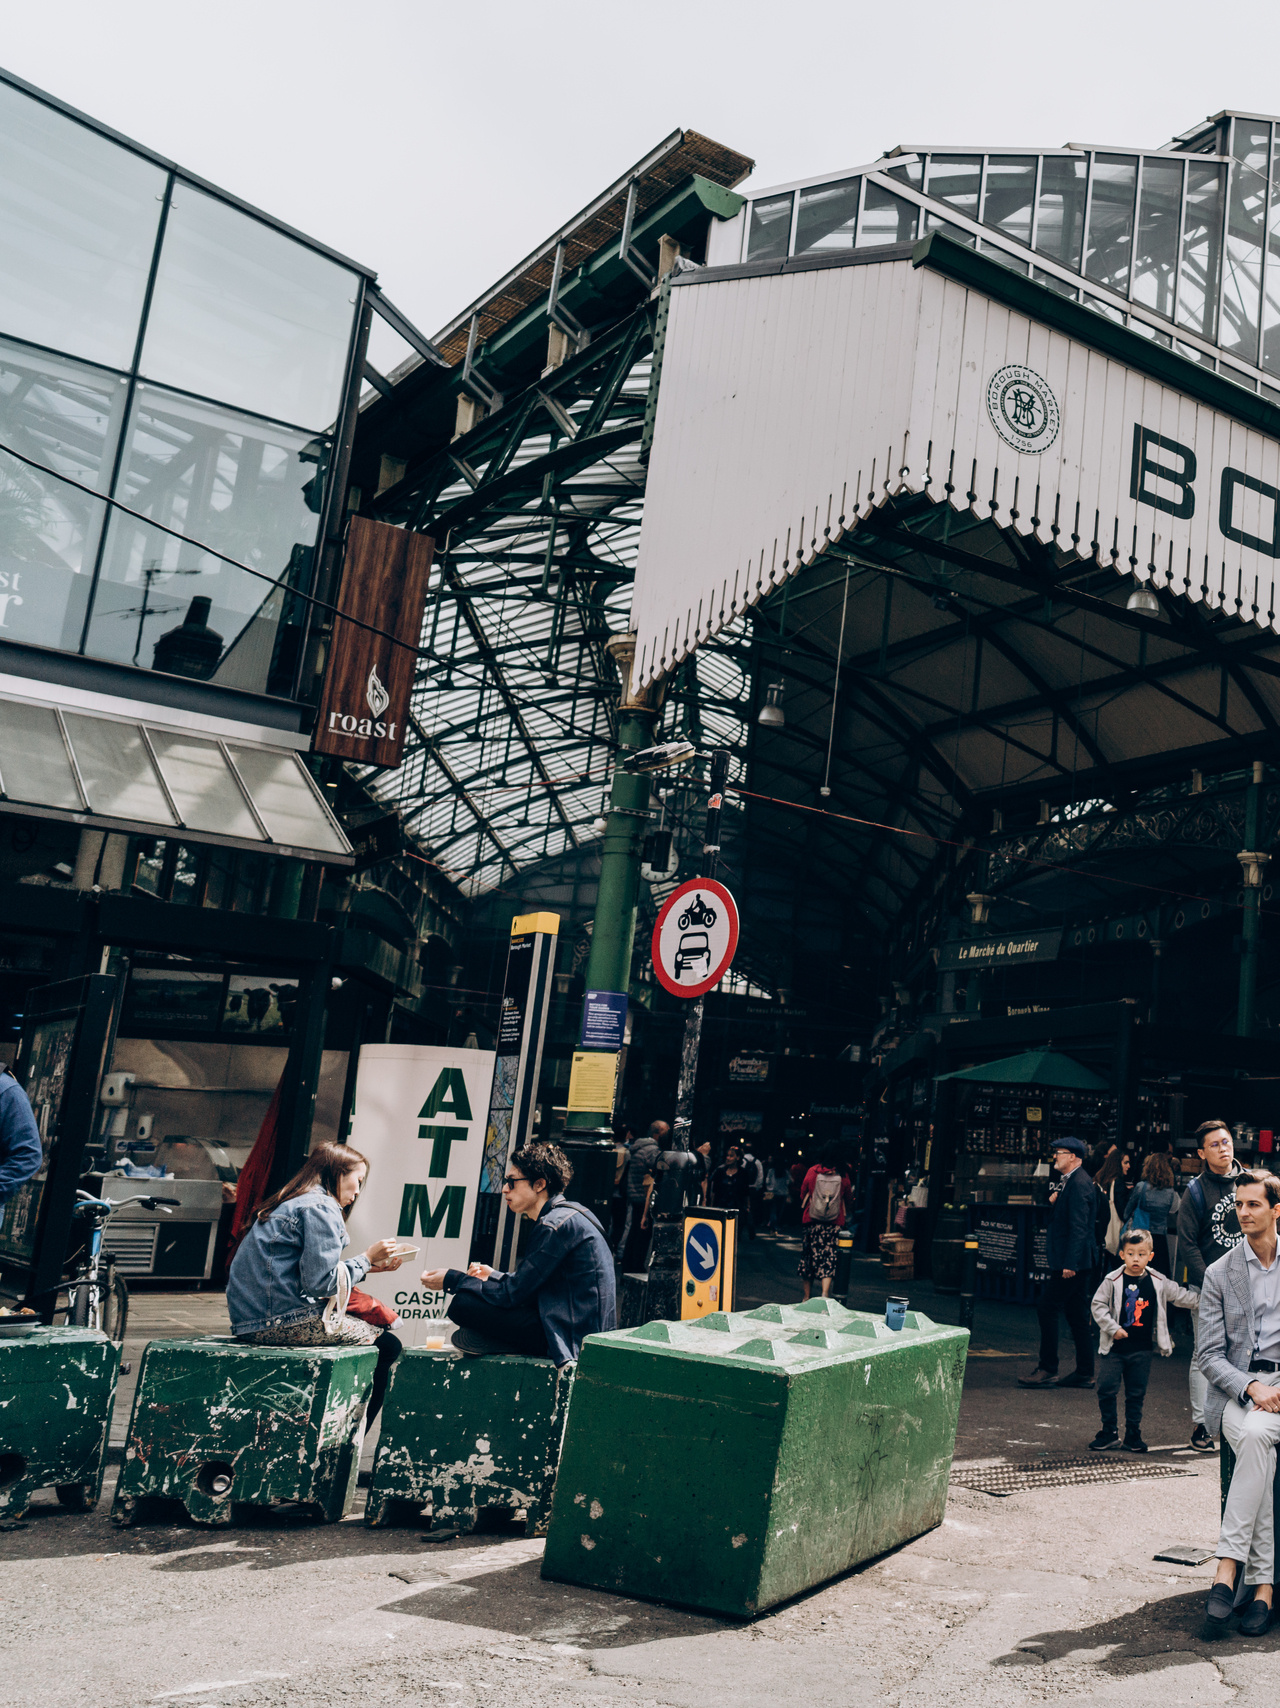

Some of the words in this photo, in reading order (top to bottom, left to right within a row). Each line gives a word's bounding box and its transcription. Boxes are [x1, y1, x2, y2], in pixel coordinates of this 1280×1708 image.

[991, 370, 1030, 411] BOROUGH
[1034, 380, 1056, 434] MARKET
[1011, 434, 1033, 448] 1756
[329, 711, 398, 741] roast
[958, 946, 968, 959] Le
[968, 943, 996, 958] Marché
[996, 942, 1006, 955] du
[1007, 939, 1039, 956] Quartier
[397, 1067, 474, 1239] ATM
[394, 1291, 447, 1306] CASH
